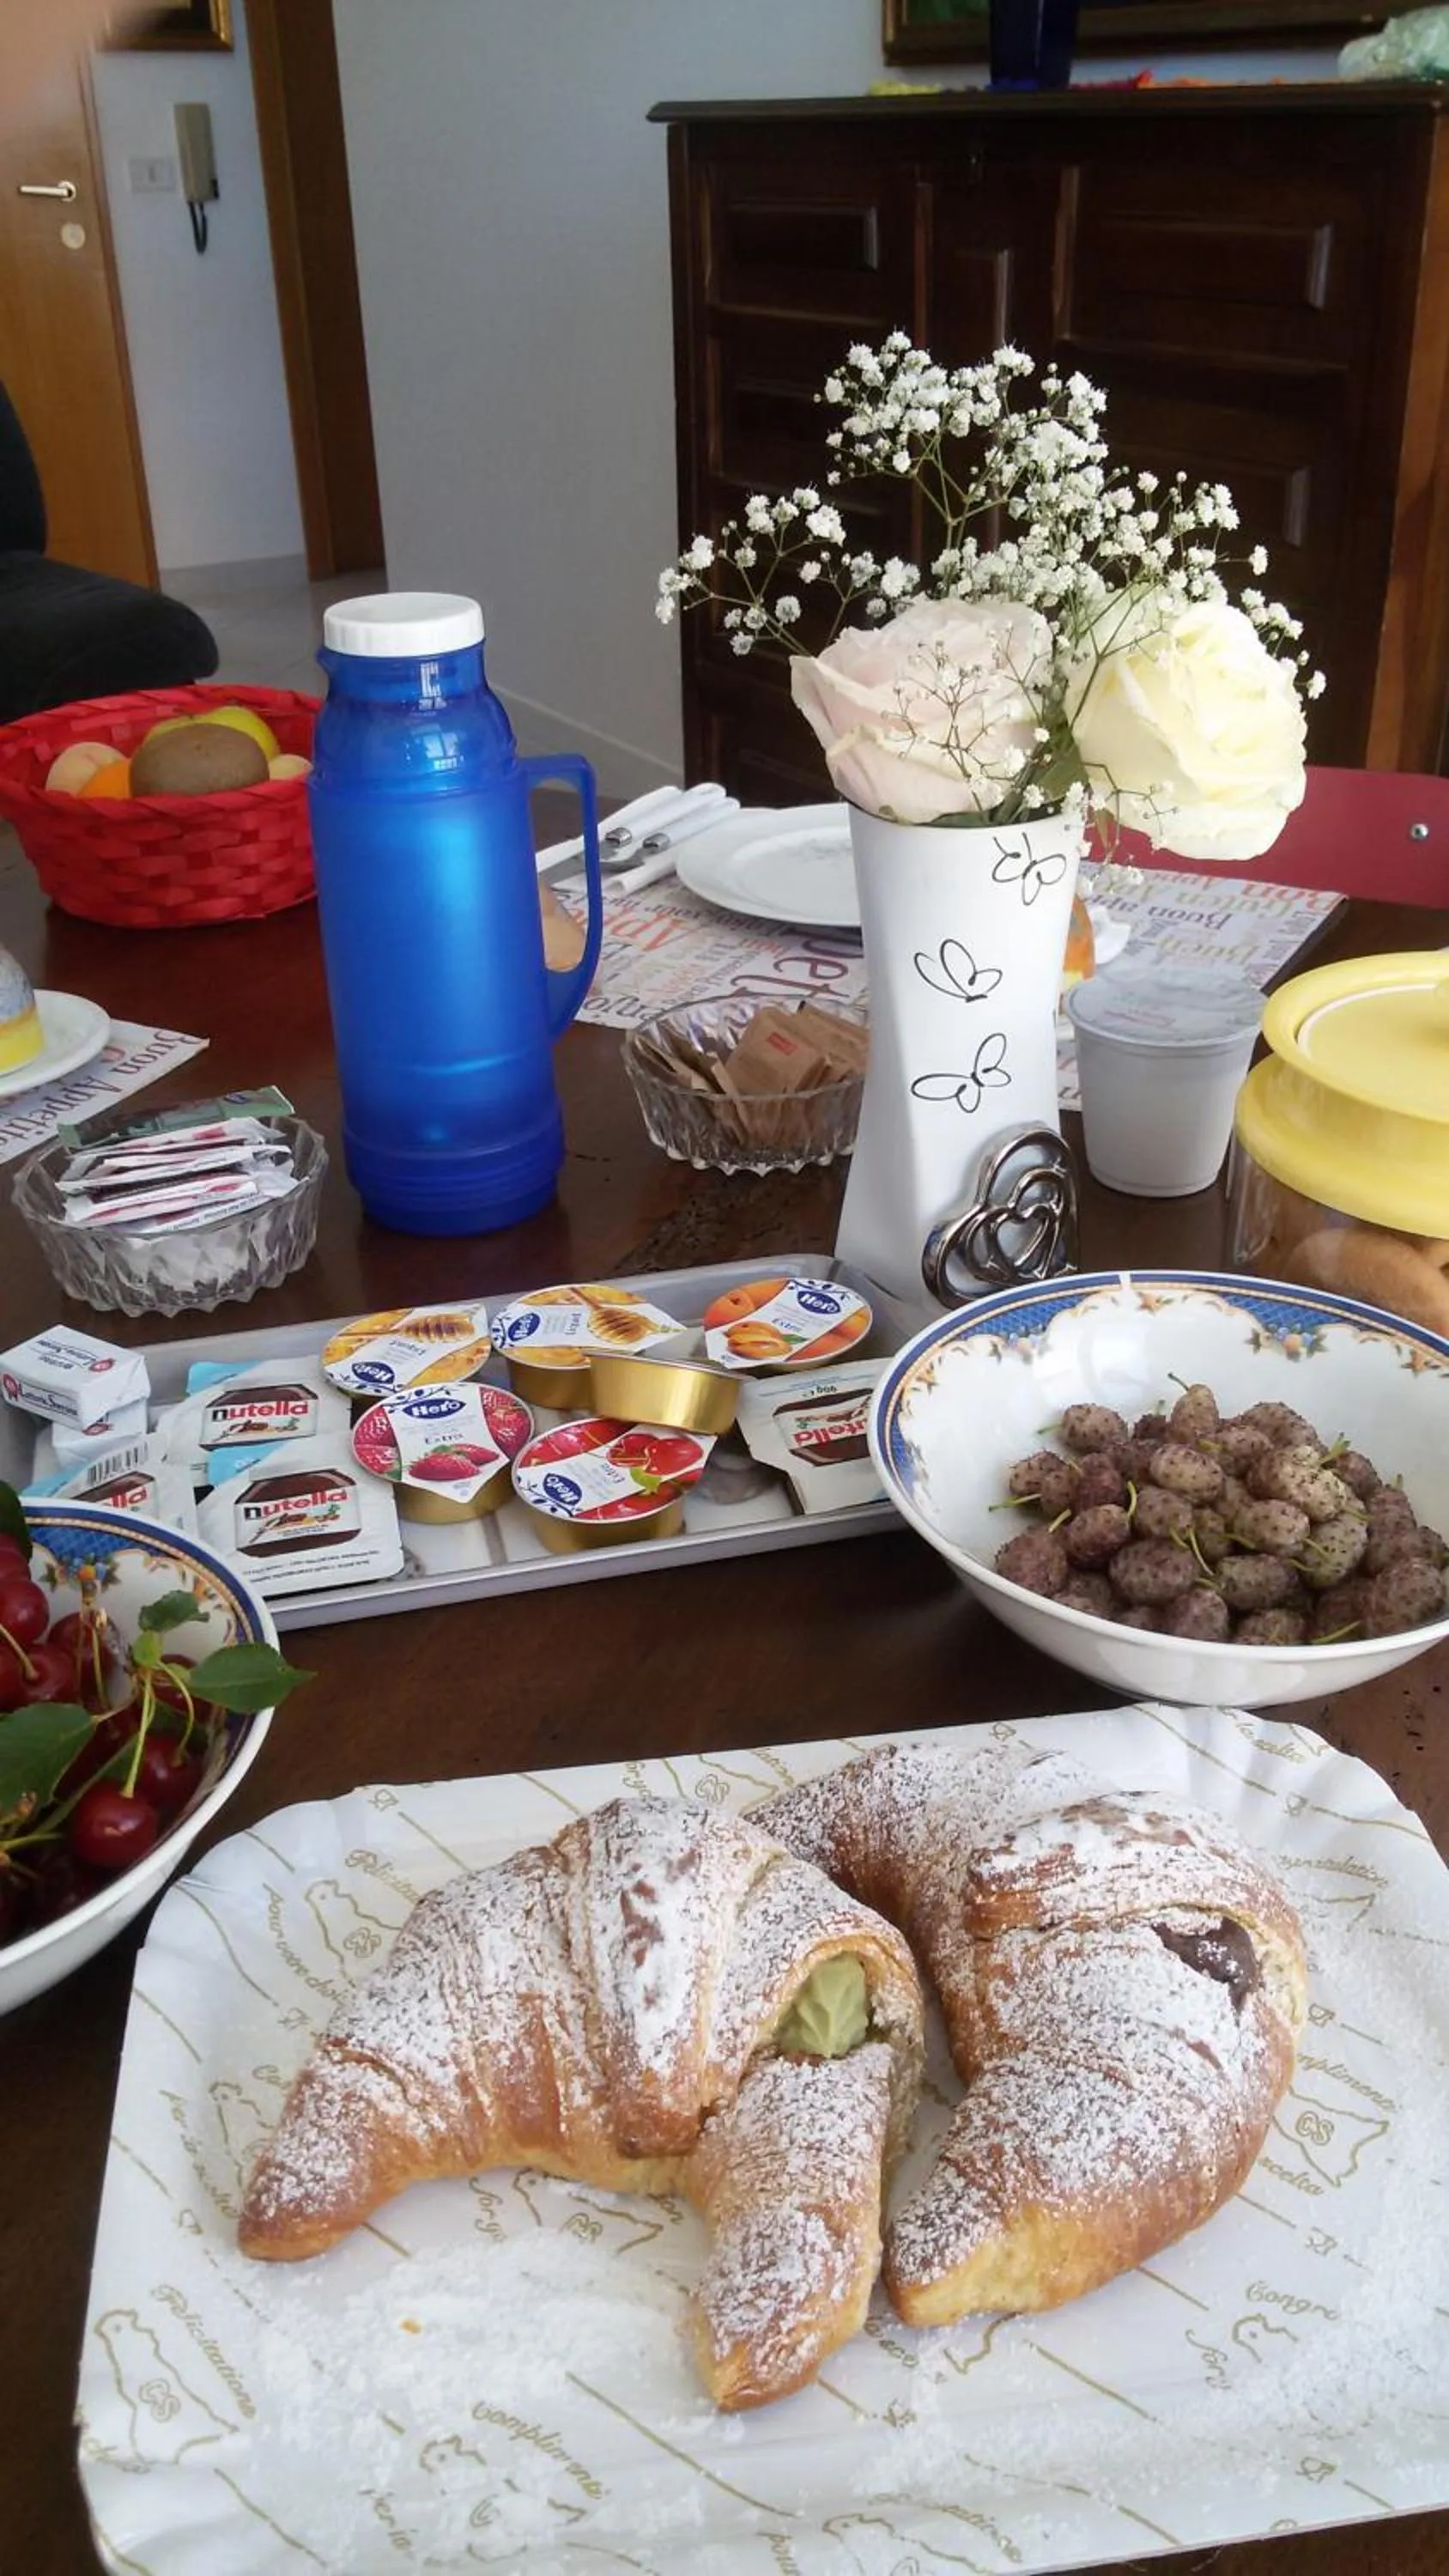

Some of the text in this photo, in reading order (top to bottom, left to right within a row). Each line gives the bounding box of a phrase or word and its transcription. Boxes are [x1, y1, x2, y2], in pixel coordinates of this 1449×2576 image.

[800, 1293, 838, 1313] Hero
[354, 1364, 393, 1382] Hero
[211, 1400, 310, 1423] nutella
[409, 1399, 461, 1418] Hero
[244, 1490, 349, 1520] nutella
[1296, 2110, 1334, 2145] CS
[142, 2379, 181, 2420] CS
